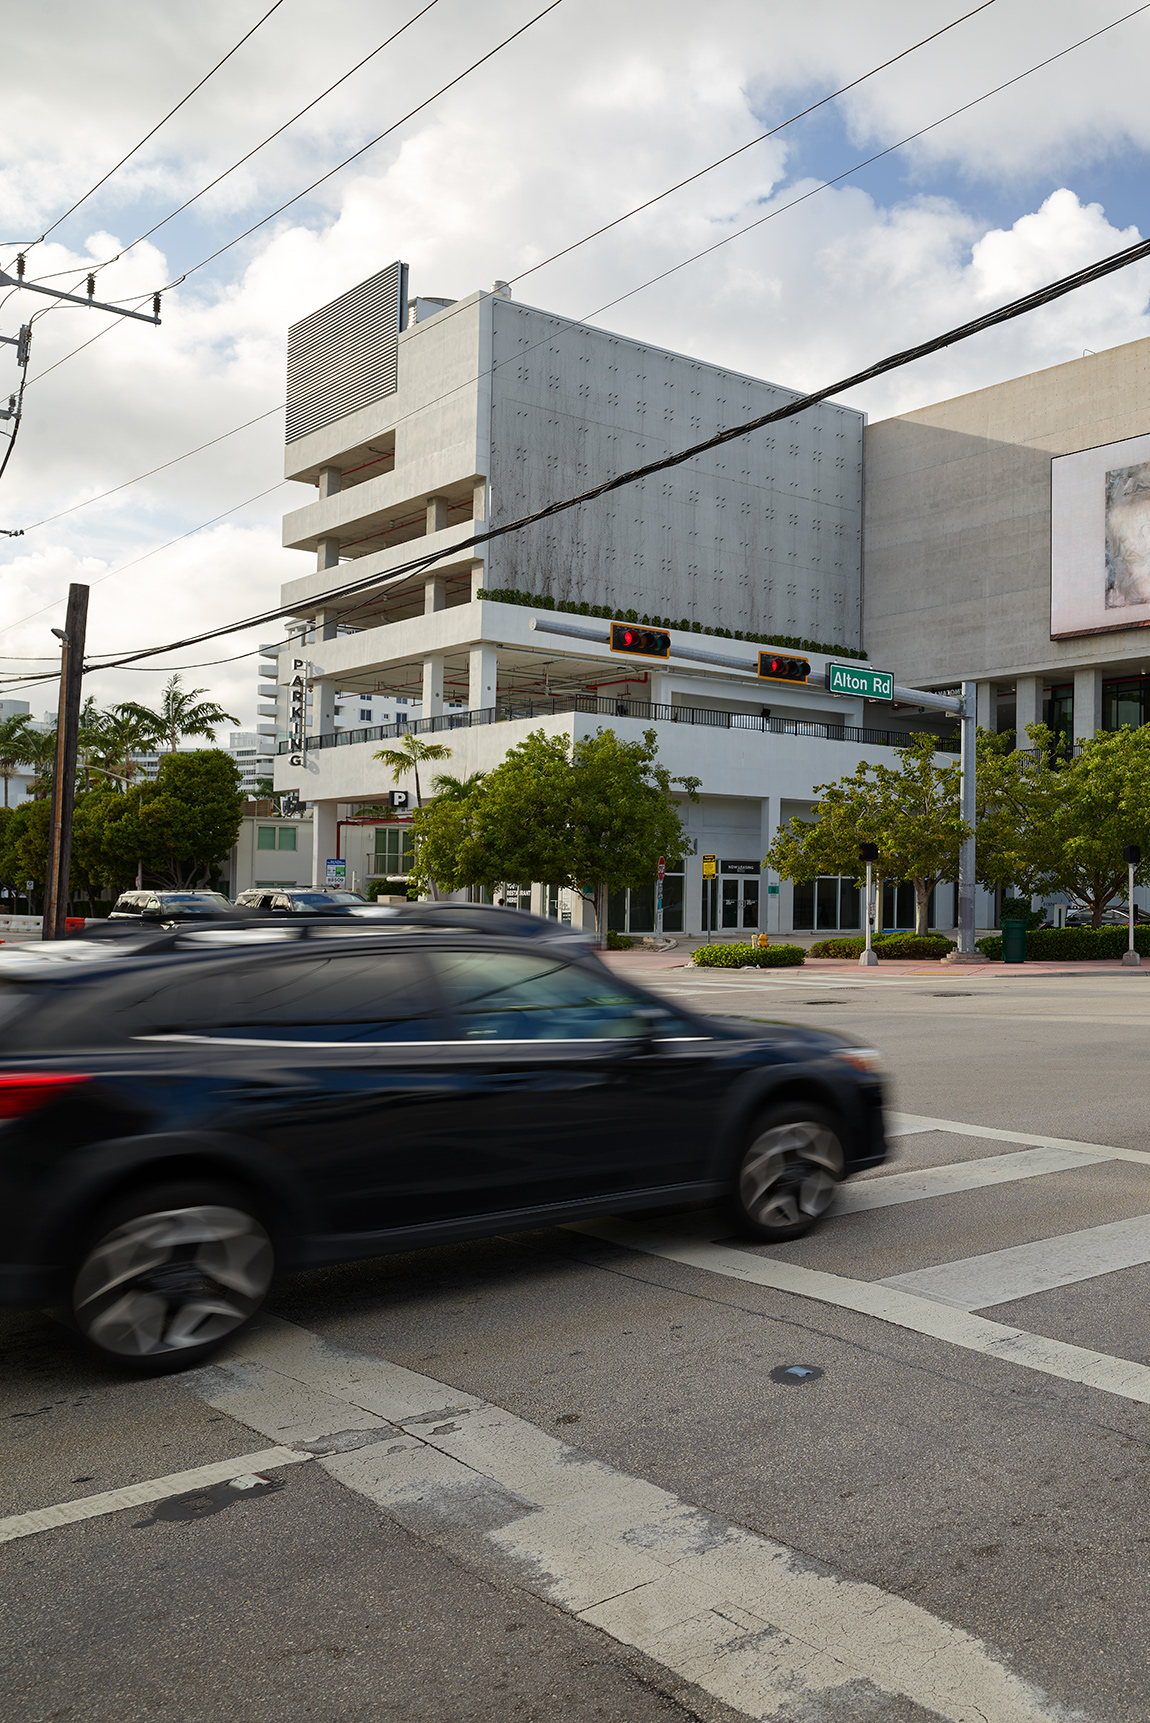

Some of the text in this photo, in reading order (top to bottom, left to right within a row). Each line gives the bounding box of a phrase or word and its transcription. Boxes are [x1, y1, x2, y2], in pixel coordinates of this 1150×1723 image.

[833, 671, 890, 694] Alton Rd
[288, 658, 304, 767] PARKING
[393, 792, 406, 805] P
